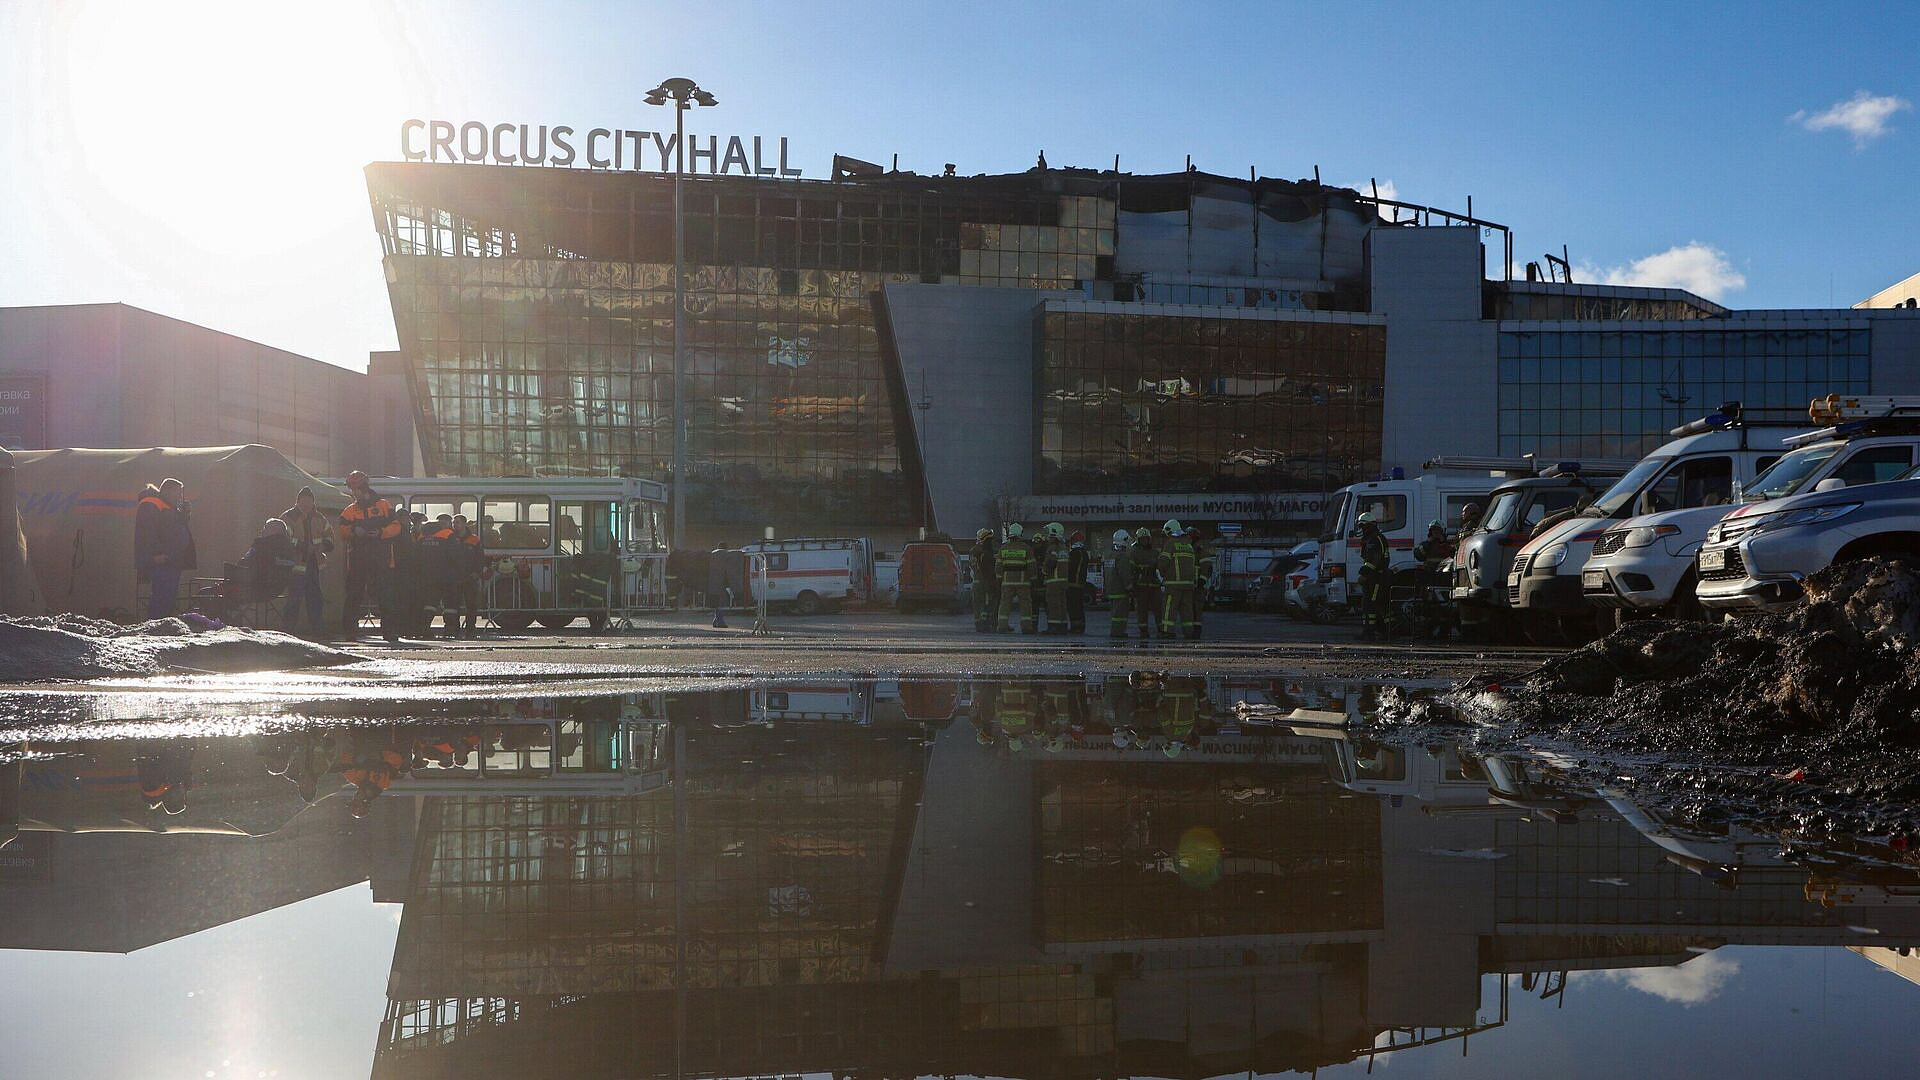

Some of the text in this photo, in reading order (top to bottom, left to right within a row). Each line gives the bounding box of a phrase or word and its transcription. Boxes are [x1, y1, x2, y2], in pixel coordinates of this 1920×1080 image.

[401, 118, 803, 175] CROCUS CITY HALL
[1041, 502, 1124, 516] концертный
[1128, 504, 1151, 513] зал
[1155, 503, 1199, 513] имени
[1203, 500, 1273, 513] МУСЛИМА
